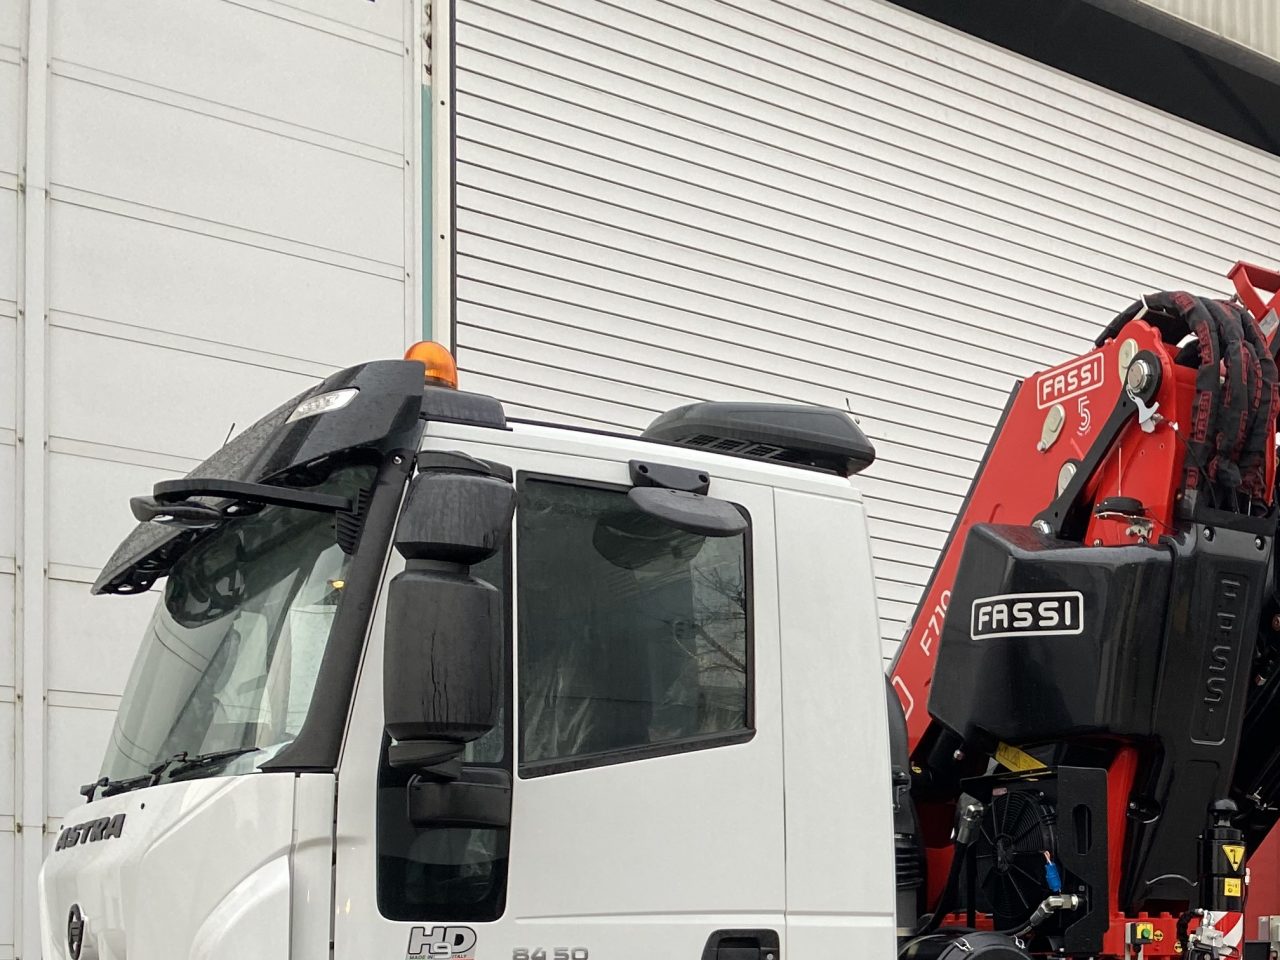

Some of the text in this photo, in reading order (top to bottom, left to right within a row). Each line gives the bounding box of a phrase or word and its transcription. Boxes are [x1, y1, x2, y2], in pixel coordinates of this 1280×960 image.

[1043, 361, 1098, 401] FASSI
[978, 601, 1071, 631] FASSI
[55, 813, 126, 852] ASTRA
